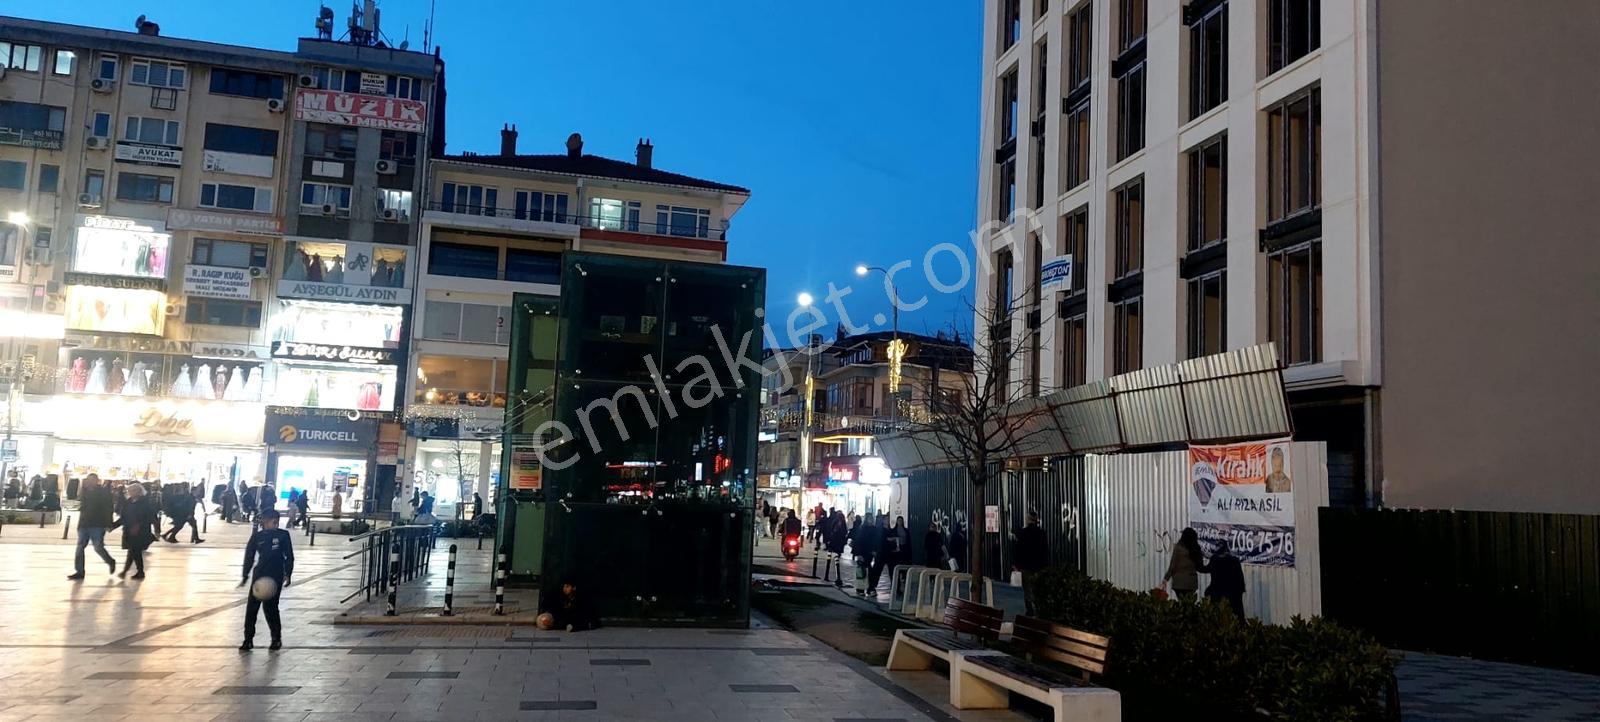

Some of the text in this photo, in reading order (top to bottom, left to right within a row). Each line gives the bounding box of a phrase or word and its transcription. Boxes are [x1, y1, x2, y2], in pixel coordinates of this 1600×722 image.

[303, 92, 421, 121] MÜZİK
[138, 148, 175, 158] AVUKAT
[194, 213, 233, 225] VATAN
[292, 283, 398, 300] AYŞEGÜL AYDIN
[202, 346, 258, 358] MODA
[299, 429, 358, 442] TURKCELL
